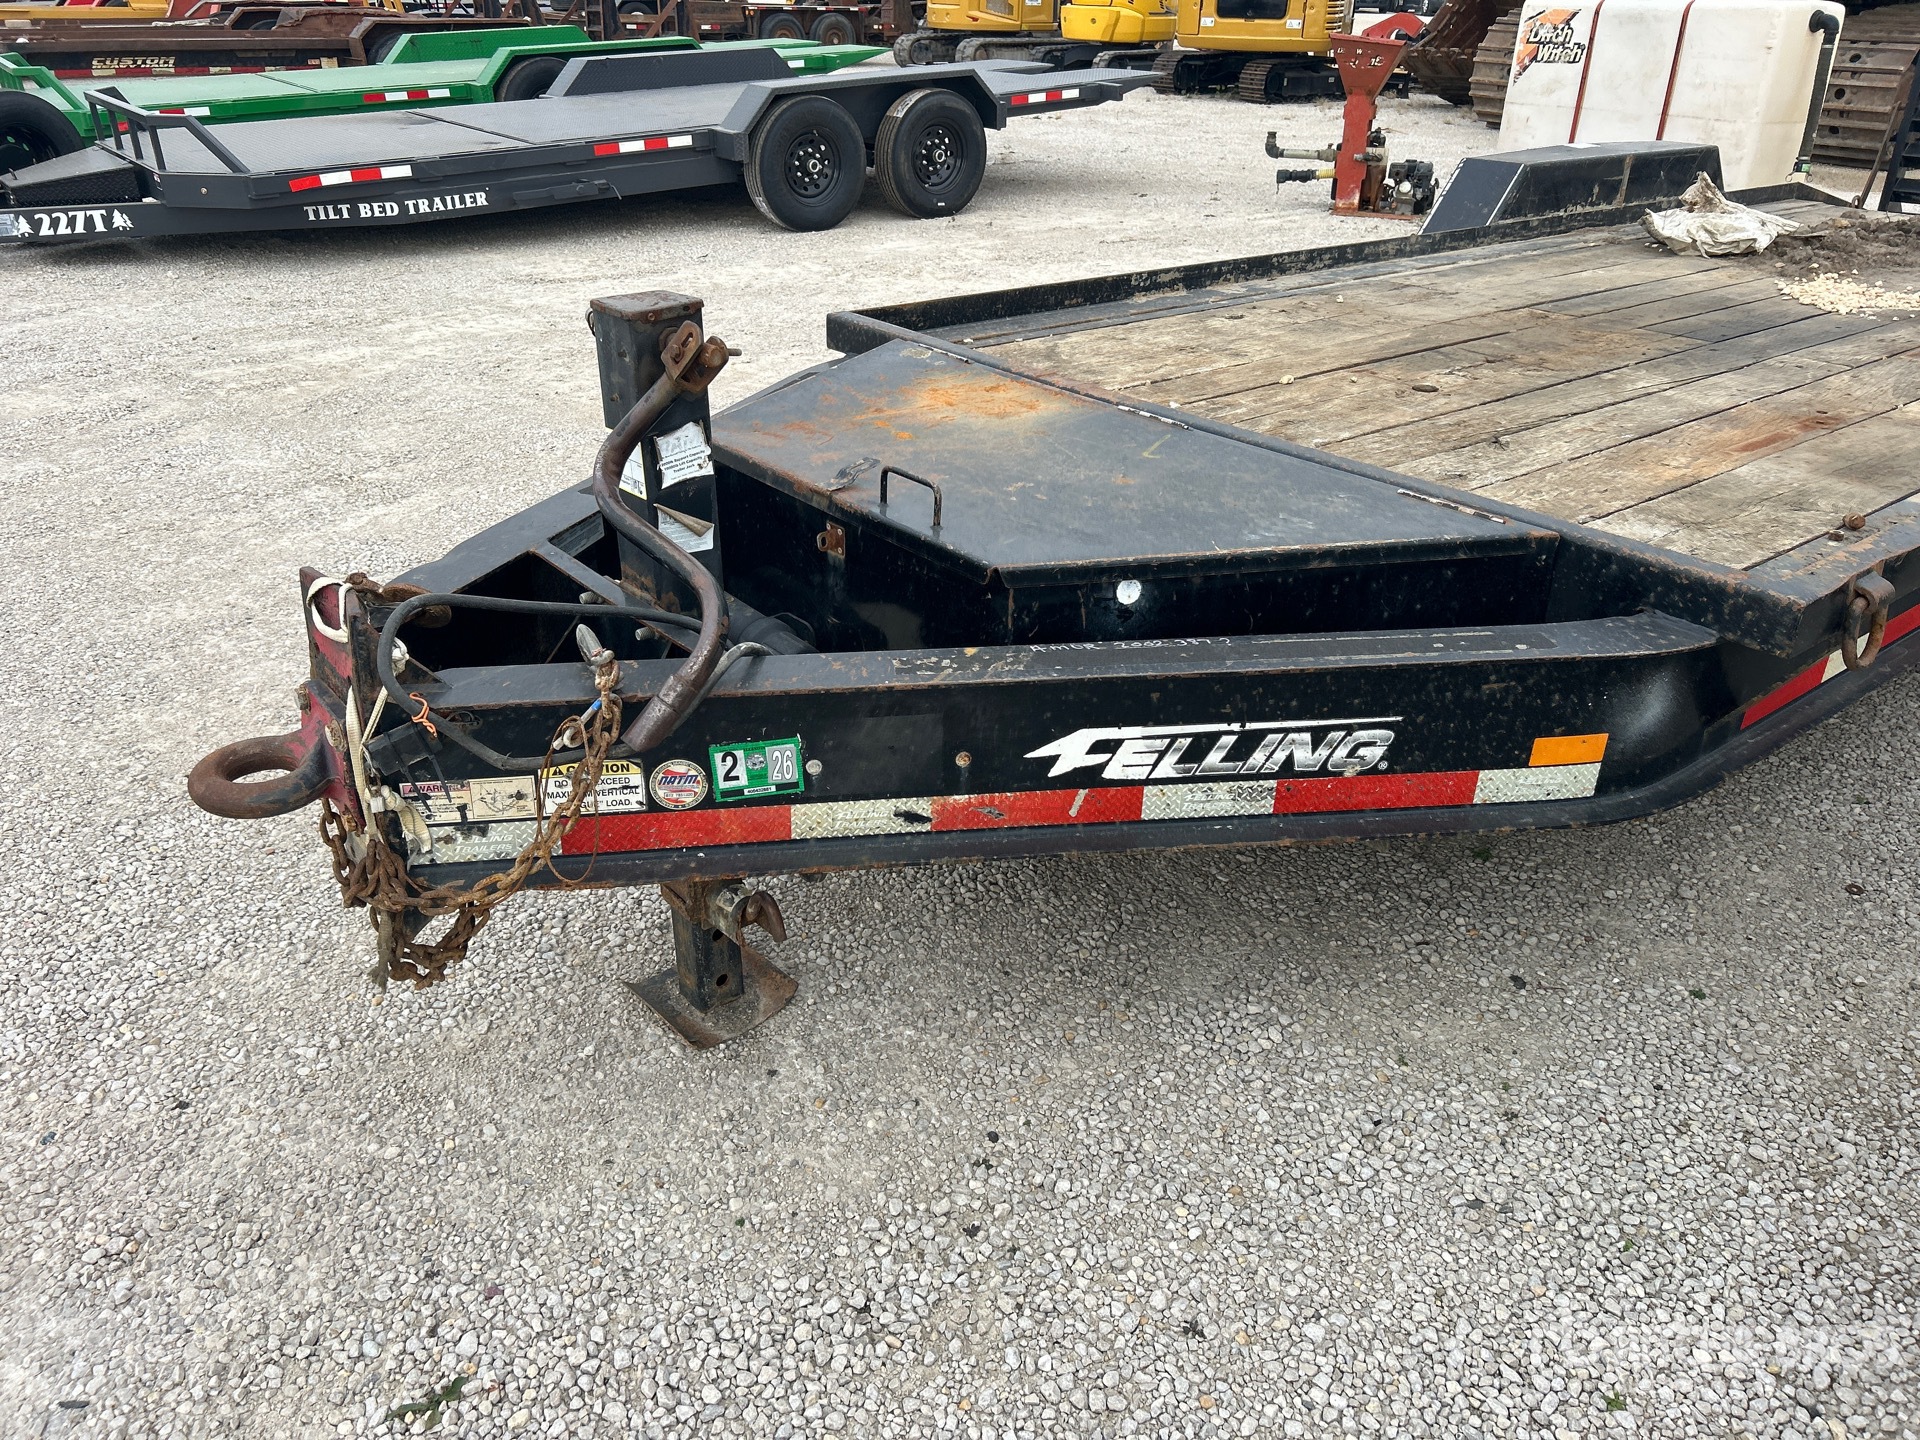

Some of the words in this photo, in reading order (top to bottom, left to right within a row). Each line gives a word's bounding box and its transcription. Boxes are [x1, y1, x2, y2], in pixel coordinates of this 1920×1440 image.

[92, 57, 176, 65] CUSTOM
[1535, 43, 1587, 63] Witch
[304, 203, 351, 221] TILT
[357, 201, 400, 218] BED
[404, 190, 490, 215] TRAILER
[34, 209, 108, 237] 227T
[721, 751, 740, 782] 2
[772, 749, 793, 780] 26
